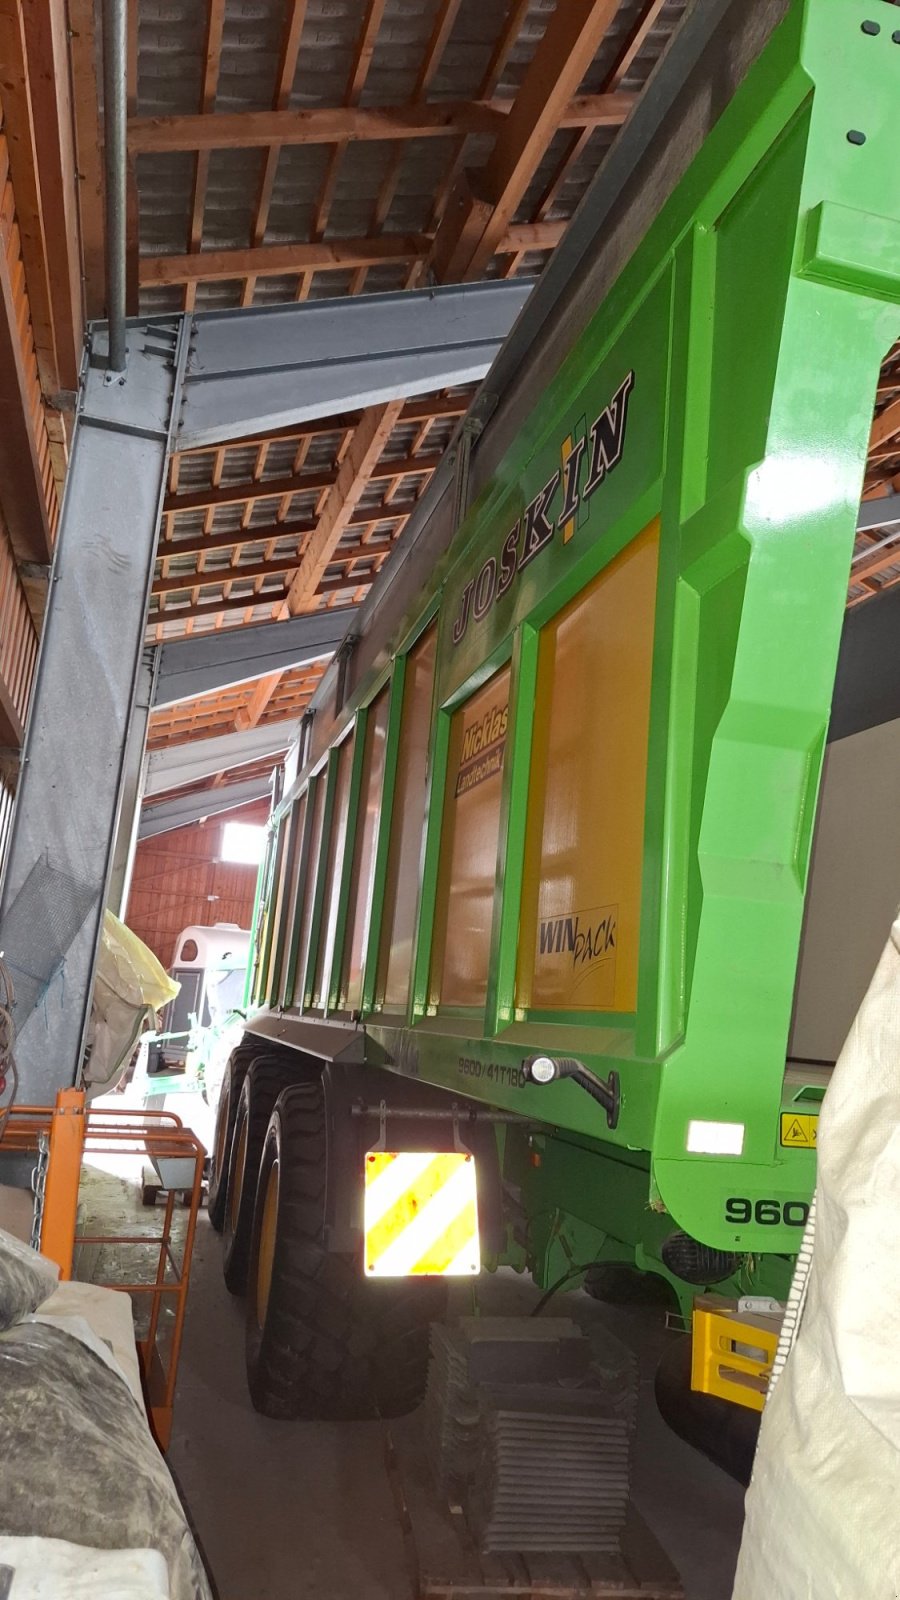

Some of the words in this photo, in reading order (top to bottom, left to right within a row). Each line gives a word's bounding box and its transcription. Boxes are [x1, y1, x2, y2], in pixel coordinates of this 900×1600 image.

[453, 369, 635, 644] JOSKIN
[460, 704, 509, 765] Nicklas
[725, 1197, 810, 1227] 960
